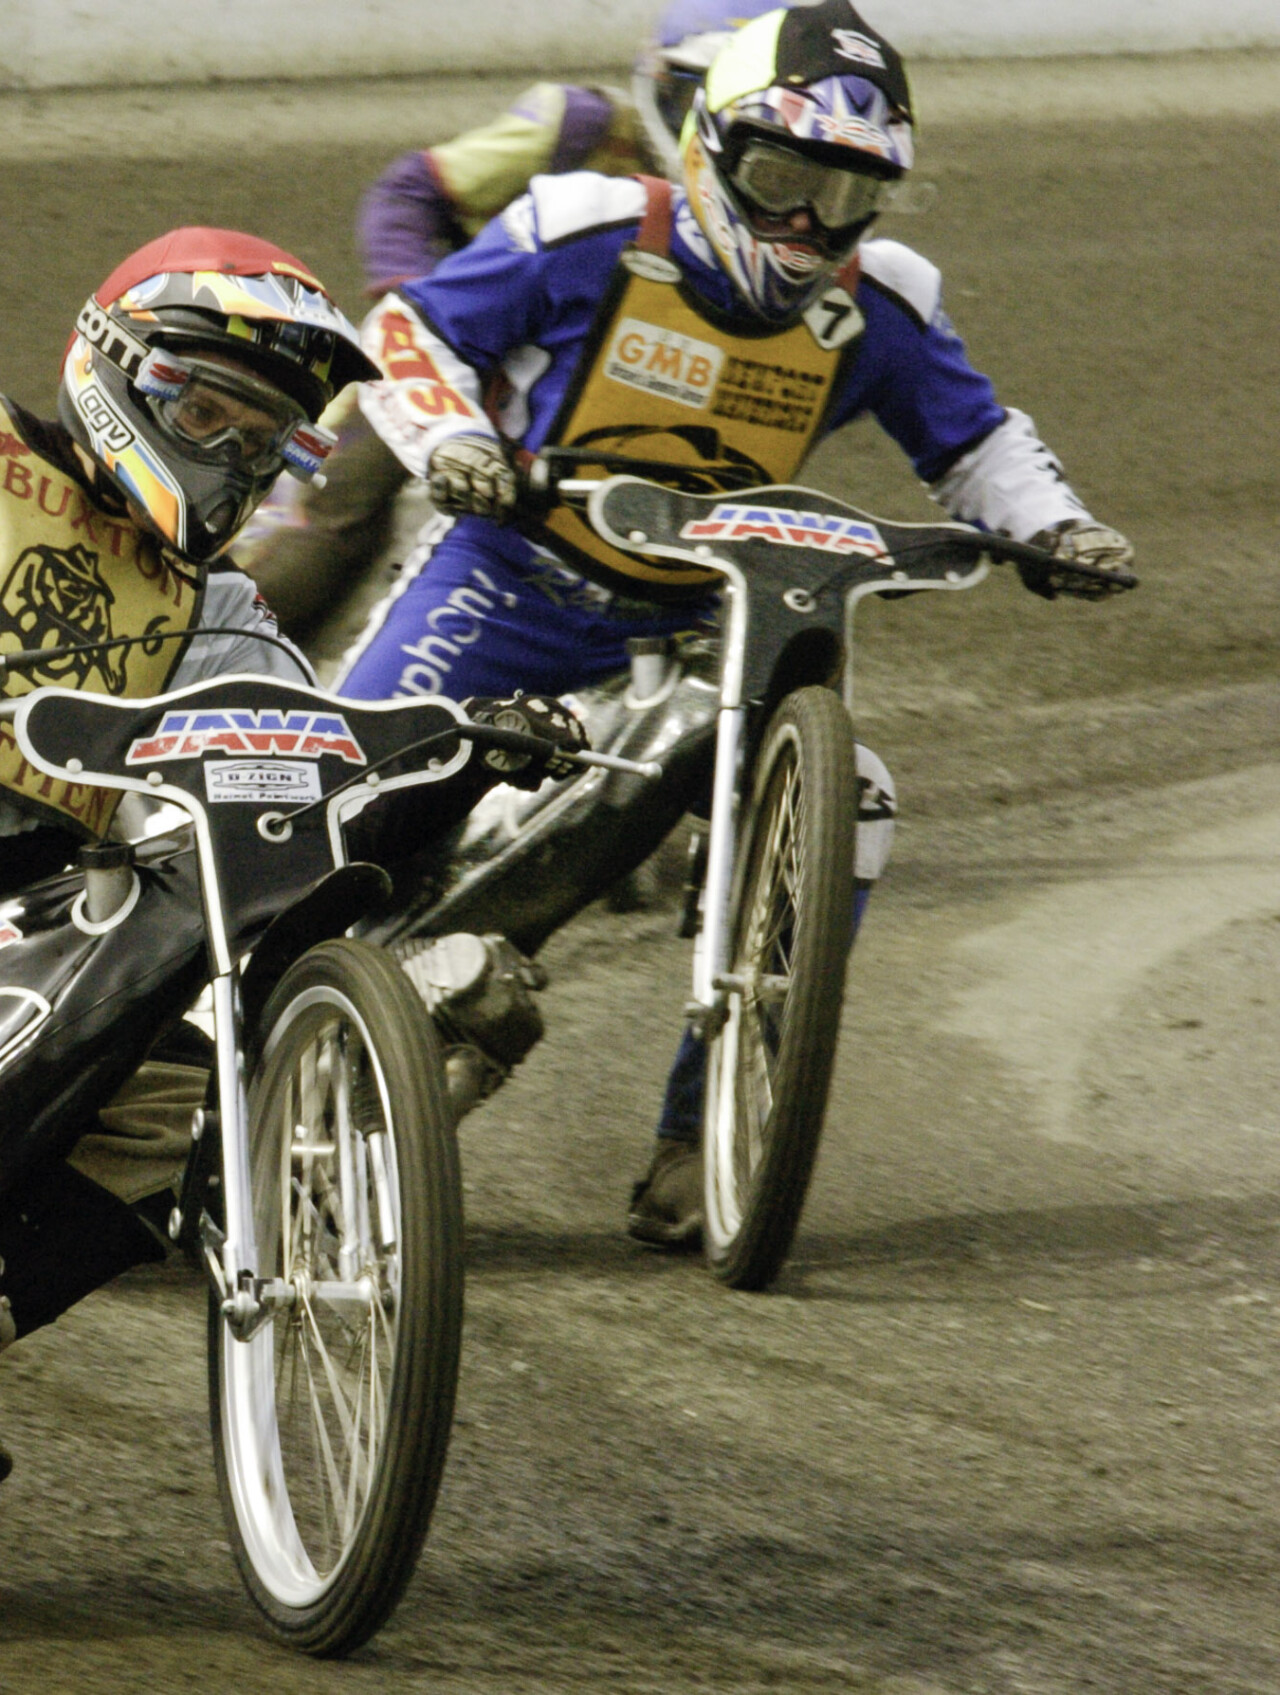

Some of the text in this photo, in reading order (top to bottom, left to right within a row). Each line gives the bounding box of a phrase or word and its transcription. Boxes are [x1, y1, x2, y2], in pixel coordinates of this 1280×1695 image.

[77, 298, 150, 370] COTT
[821, 301, 851, 341] 7
[617, 332, 713, 388] GMB
[680, 504, 894, 566] JAWA
[391, 568, 518, 698] phony
[127, 710, 366, 764] JAWA
